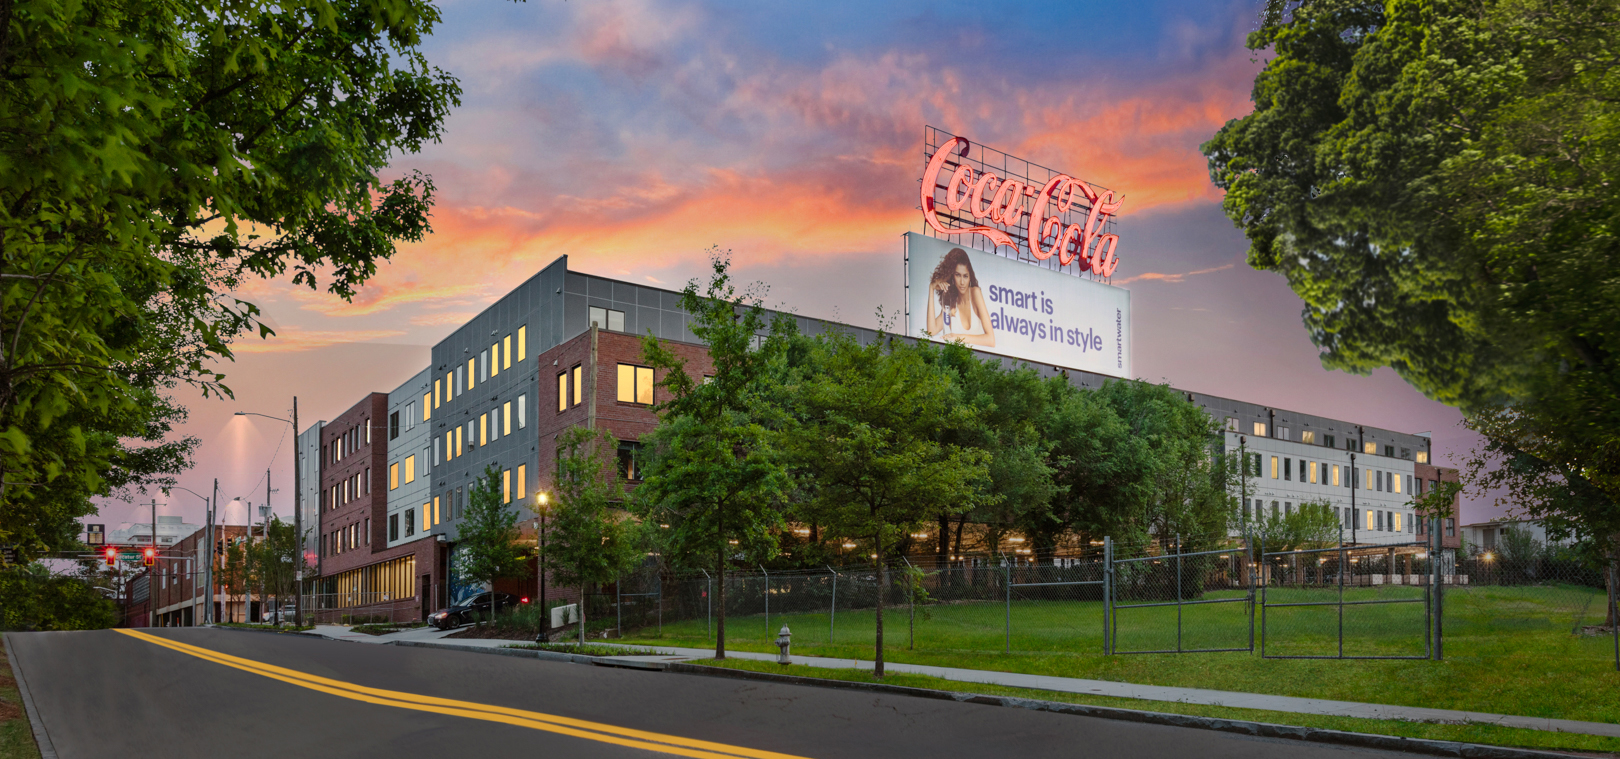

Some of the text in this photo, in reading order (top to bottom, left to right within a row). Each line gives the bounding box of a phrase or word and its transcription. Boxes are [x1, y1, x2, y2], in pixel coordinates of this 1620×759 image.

[989, 284, 1054, 315] smart is
[990, 306, 1103, 353] always in style
